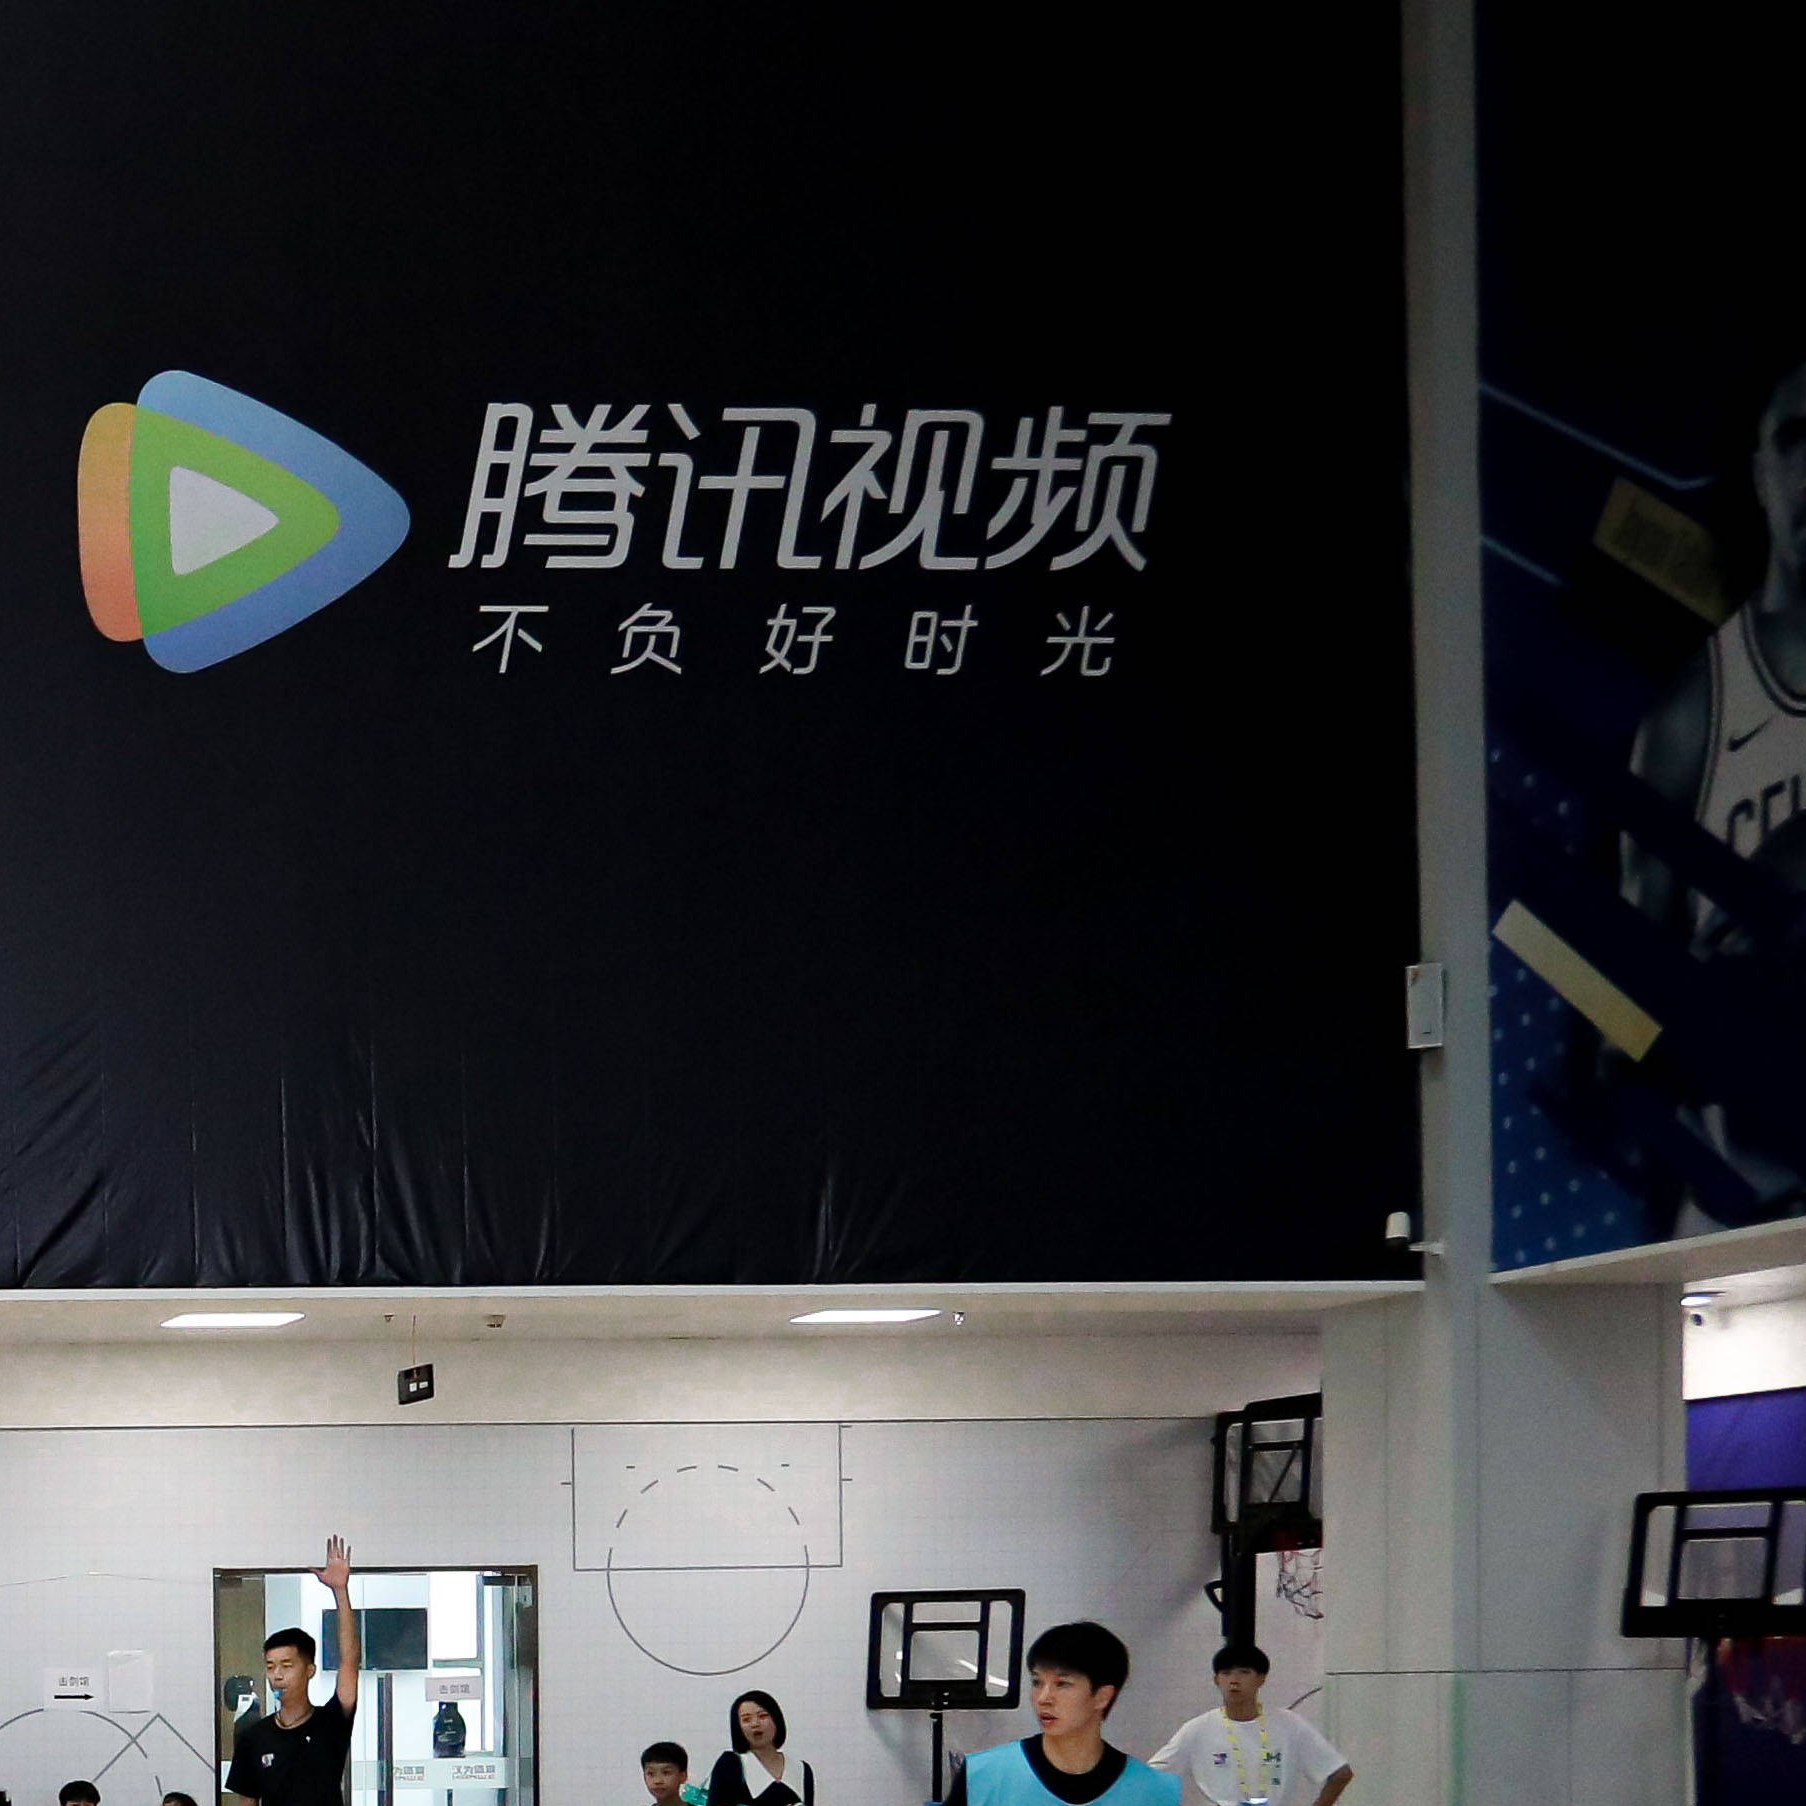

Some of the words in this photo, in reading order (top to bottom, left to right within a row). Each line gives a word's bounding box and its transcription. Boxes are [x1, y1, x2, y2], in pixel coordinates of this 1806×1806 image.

[449, 402, 1171, 571] 腾讯视频
[472, 603, 1115, 676] 不负好时光
